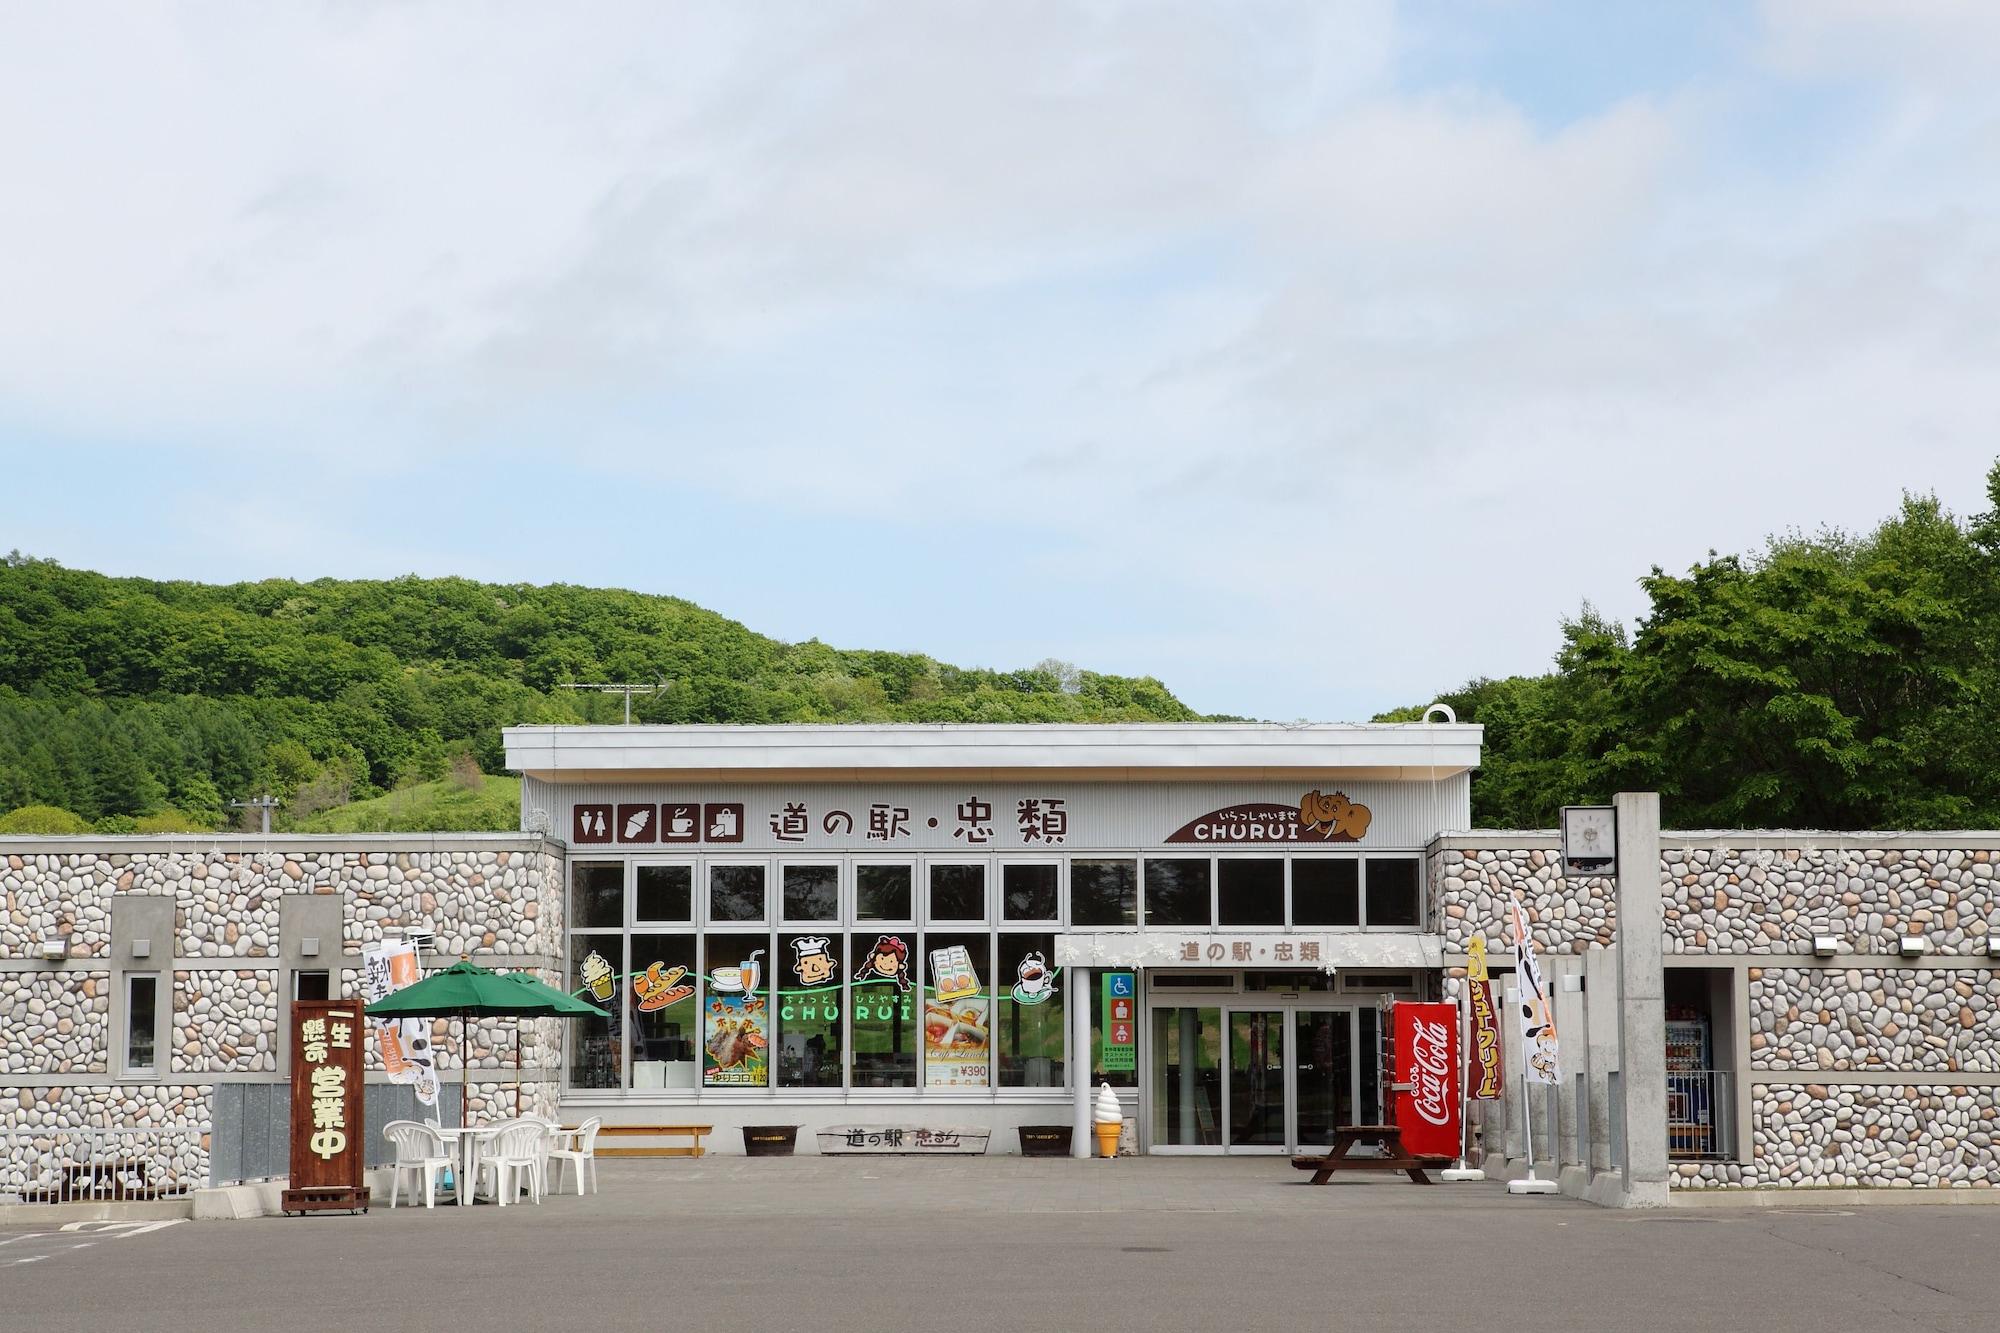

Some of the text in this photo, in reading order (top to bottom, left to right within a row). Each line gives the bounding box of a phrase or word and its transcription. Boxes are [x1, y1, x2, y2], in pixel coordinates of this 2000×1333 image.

[770, 796, 1067, 844] 道の駅・忠類
[1219, 810, 1297, 821] いらっしゃいませ
[1193, 823, 1298, 840] CHURUI
[1180, 941, 1320, 962] 道の駅・忠類
[961, 1065, 986, 1076] ¥390
[1412, 1015, 1450, 1126] Coca-Cola
[310, 1065, 347, 1160] 営業中
